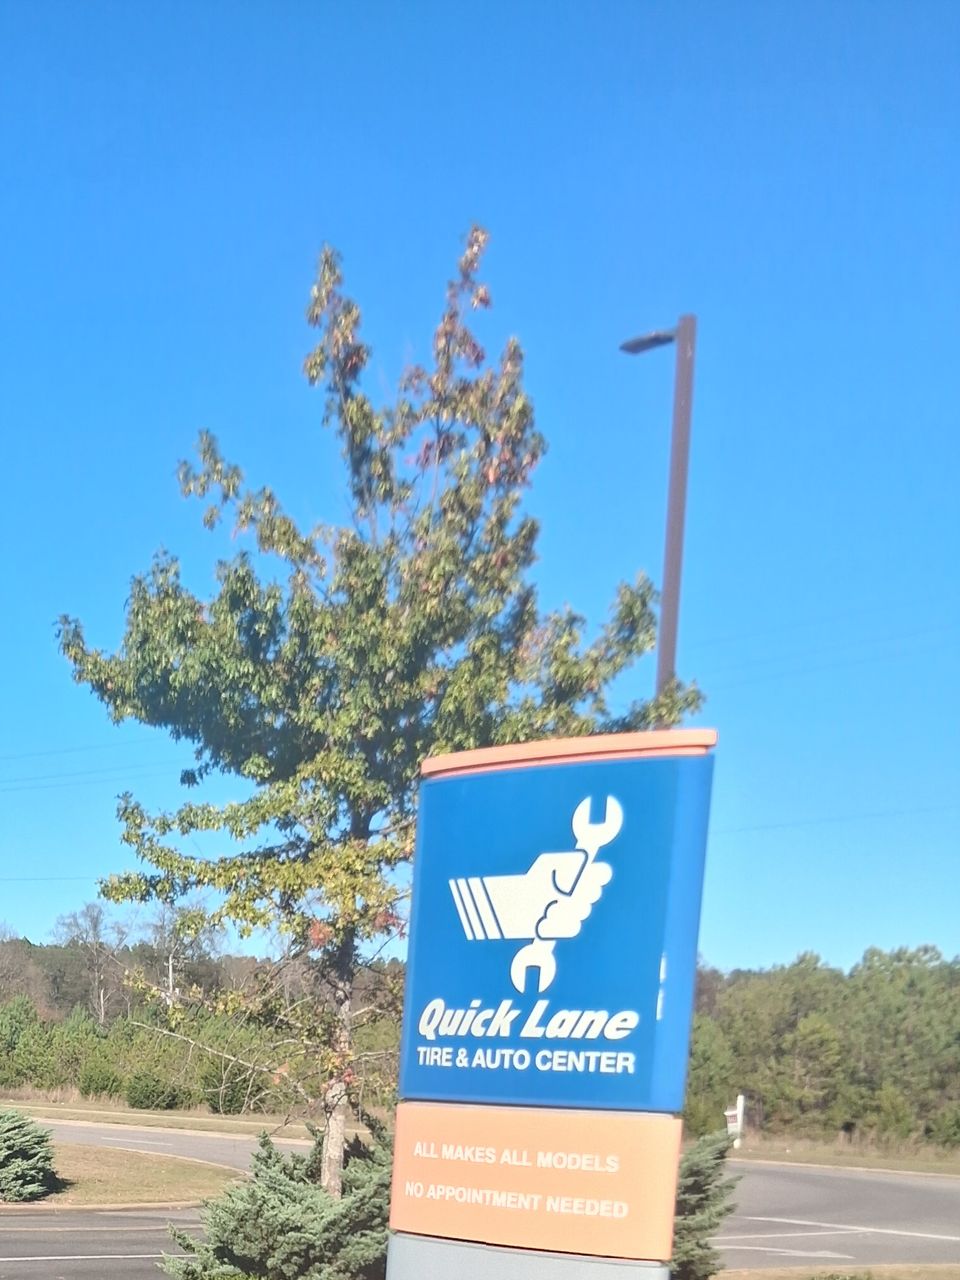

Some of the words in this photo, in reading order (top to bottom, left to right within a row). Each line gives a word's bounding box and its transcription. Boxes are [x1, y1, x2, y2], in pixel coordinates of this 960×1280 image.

[418, 998, 521, 1040] Quick
[520, 999, 640, 1040] Lane
[418, 1047, 452, 1067] TIRE
[456, 1047, 468, 1068] &
[473, 1049, 531, 1070] AUTO
[535, 1052, 636, 1074] CENTER
[413, 1141, 438, 1159] ALL
[442, 1144, 496, 1165] MAKES
[500, 1148, 532, 1167] ALL
[537, 1151, 620, 1173] MODELS
[405, 1181, 424, 1197] NO
[427, 1185, 541, 1209] APPOINTMENT
[546, 1198, 628, 1219] NEEDED
